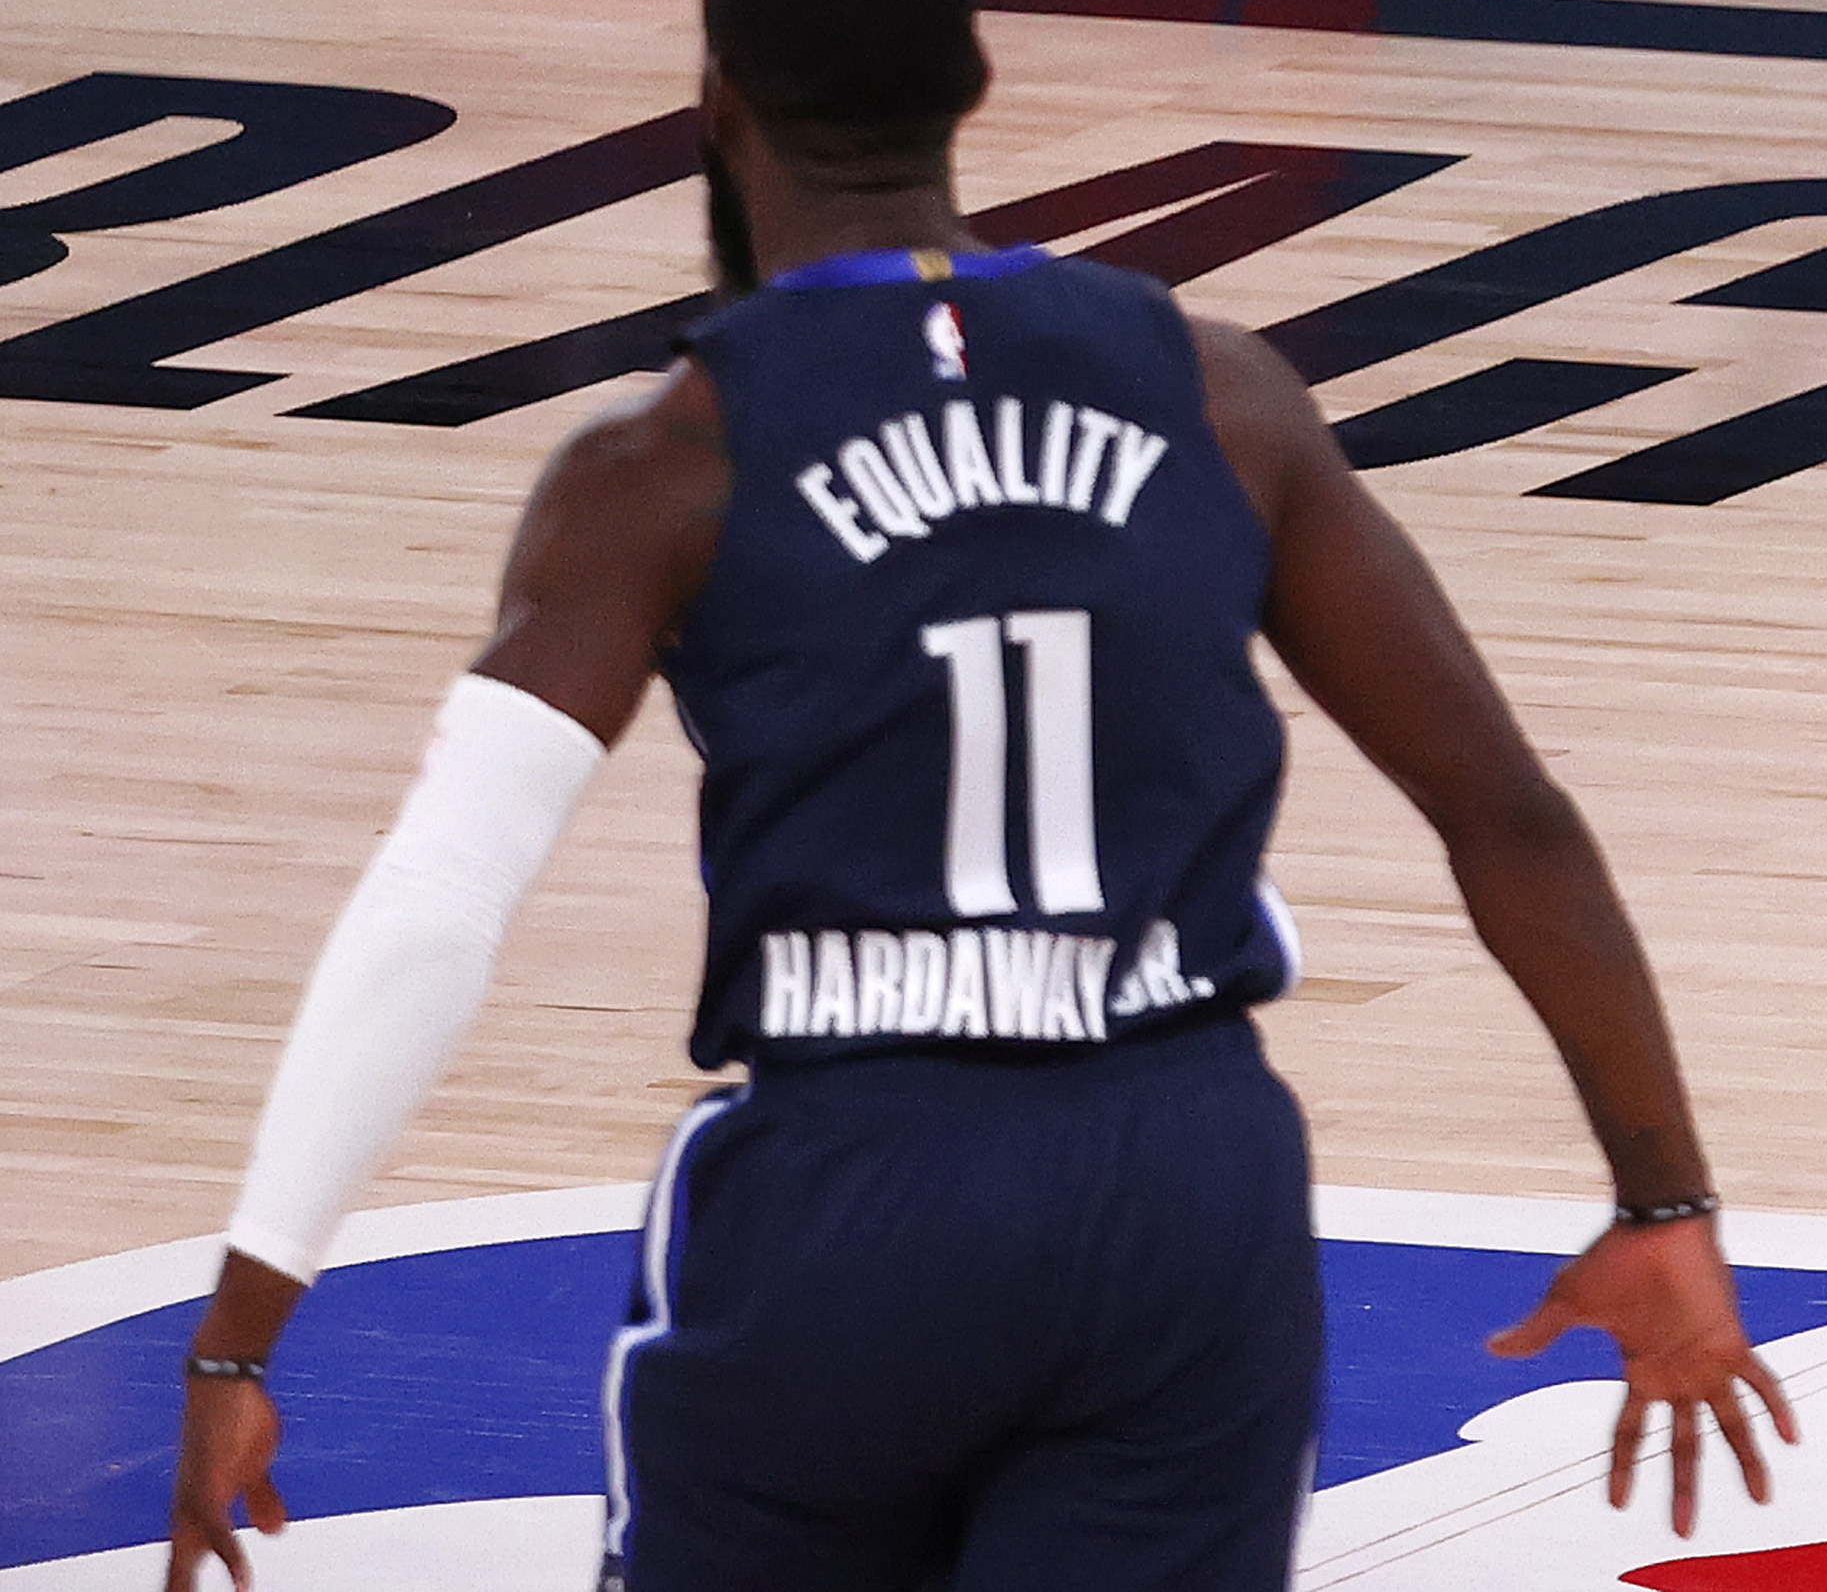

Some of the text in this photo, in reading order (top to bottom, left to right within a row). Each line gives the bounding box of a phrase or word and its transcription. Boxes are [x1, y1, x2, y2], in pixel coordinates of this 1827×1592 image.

[793, 395, 1171, 565] EQUALITY
[919, 609, 1107, 917] 11
[760, 925, 1119, 1044] HARDAWAY
